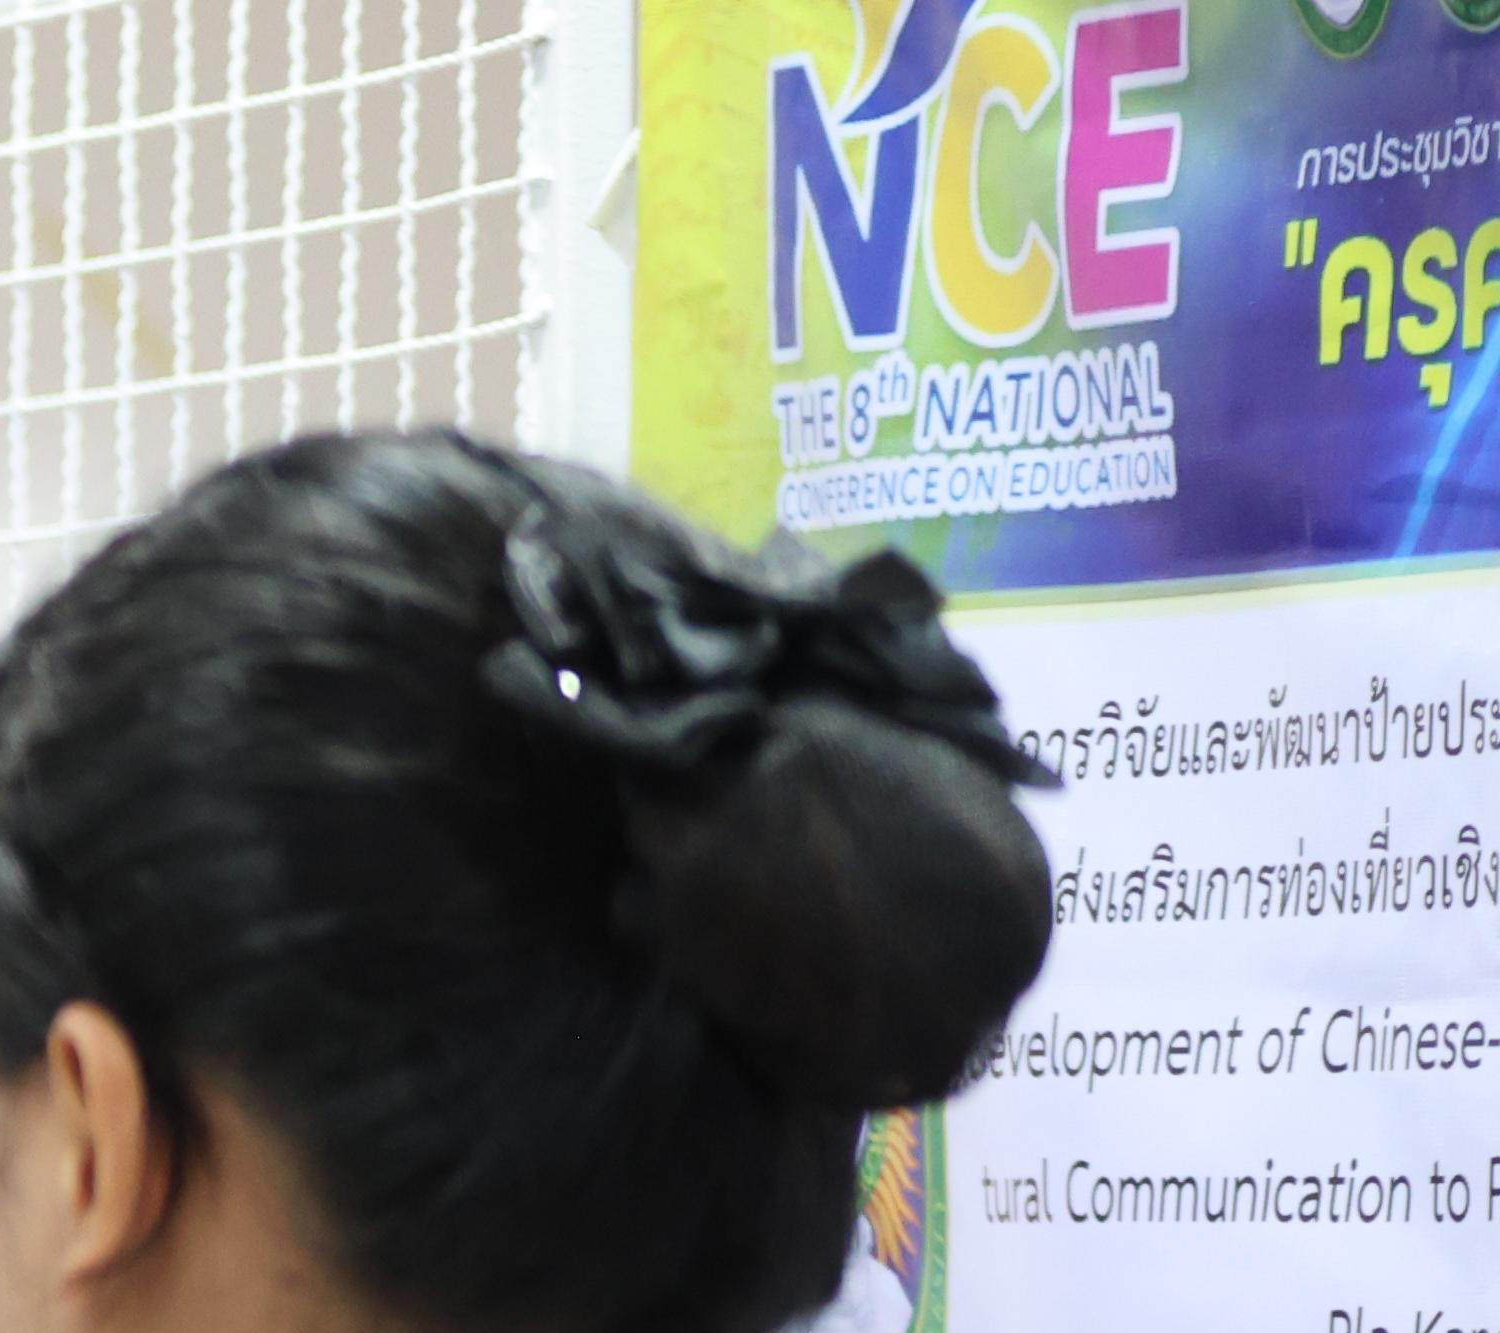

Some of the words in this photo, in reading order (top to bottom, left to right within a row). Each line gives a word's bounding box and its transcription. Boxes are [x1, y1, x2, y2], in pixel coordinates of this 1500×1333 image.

[768, 0, 1188, 356] NCE
[778, 389, 836, 456] THE
[849, 357, 909, 444] 8th
[921, 354, 1167, 438] NATIONAL
[783, 464, 941, 521] CONFERENCE
[948, 464, 997, 503] ON
[1009, 448, 1172, 498] EDUCATION
[1257, 1006, 1312, 1075] of
[1321, 1005, 1500, 1074] Chinese-
[981, 1157, 1054, 1224] tural
[1066, 1157, 1413, 1224] Communication
[1429, 1160, 1471, 1224] to
